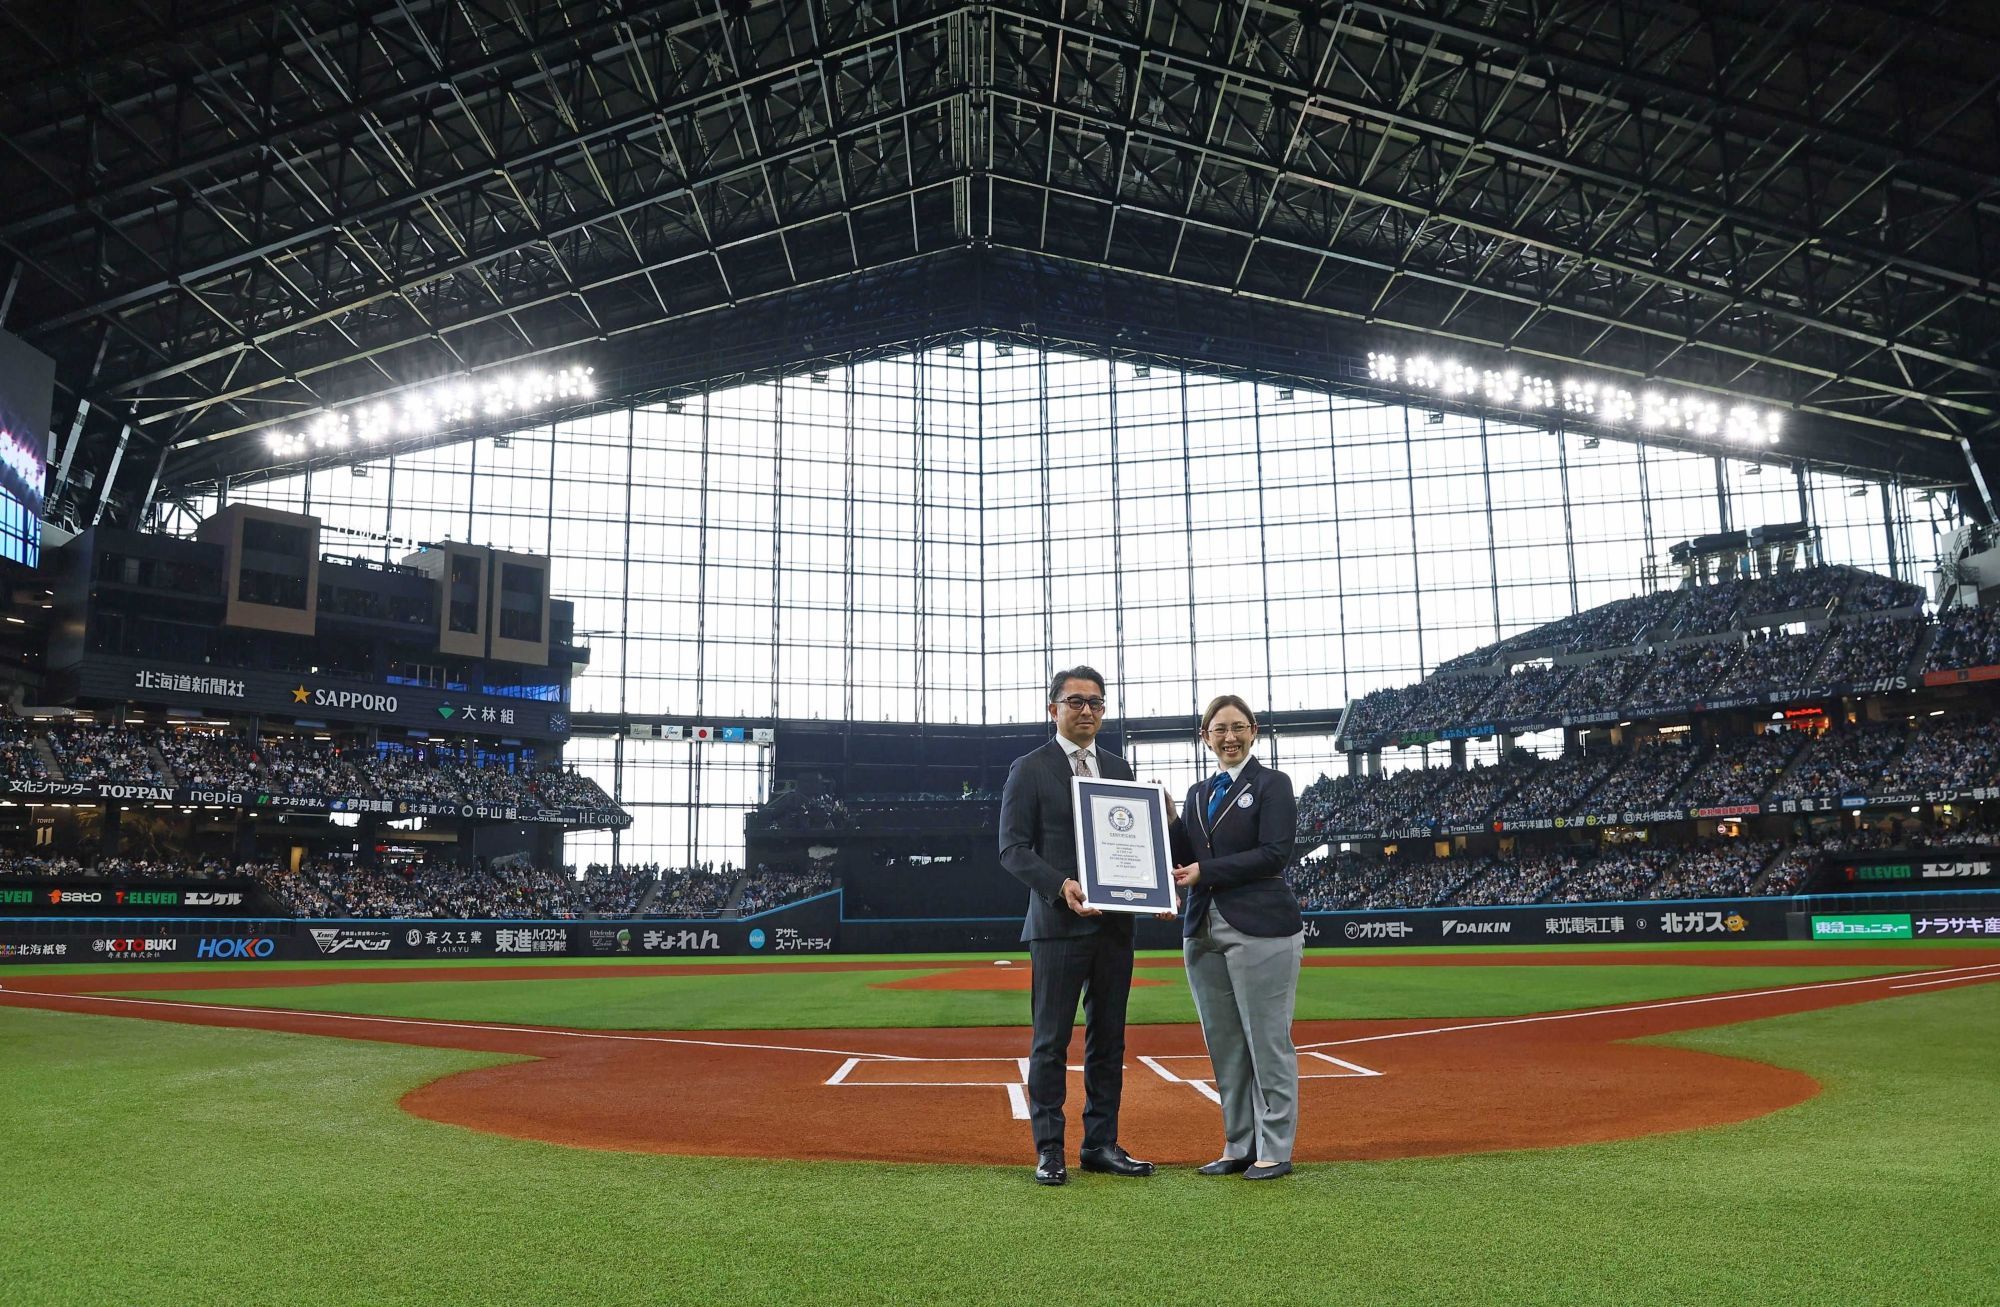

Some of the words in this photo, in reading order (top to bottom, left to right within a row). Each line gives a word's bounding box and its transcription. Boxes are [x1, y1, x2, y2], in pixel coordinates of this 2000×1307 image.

[136, 670, 245, 698] 北海道新聞社
[1873, 676, 1907, 692] HIS
[315, 689, 398, 713] SAPPORO
[462, 705, 516, 725] 大林組
[1510, 723, 1545, 733] accenture
[9, 780, 92, 795] 文化シャッター
[98, 784, 175, 800] TOPPAN
[190, 790, 243, 804] nepia
[409, 803, 456, 815] 北海道バス
[476, 805, 517, 820] 中山組
[1782, 797, 1832, 813] 関電工
[537, 809, 561, 818] CSP
[597, 813, 630, 825] GROUP
[1389, 826, 1432, 839] 小山商会
[1922, 862, 1991, 878] ユンケル
[61, 892, 102, 903] sato
[184, 892, 243, 906] ユンケル
[1359, 921, 1413, 938] オカモト
[1456, 922, 1511, 934] DAIKIN
[1545, 916, 1625, 934] 東光電気工事
[1660, 911, 1726, 933] 北ガス
[495, 929, 532, 952] 東進
[532, 929, 567, 940] ハイスクール
[643, 929, 720, 950] ぎょれん
[775, 928, 798, 938] アサヒ
[18, 944, 67, 956] 北海紙管
[105, 938, 177, 952] KOTOBUKI
[197, 938, 275, 958] HOKKO
[327, 938, 391, 953] ジーベック
[775, 938, 832, 950] スーパードライ
